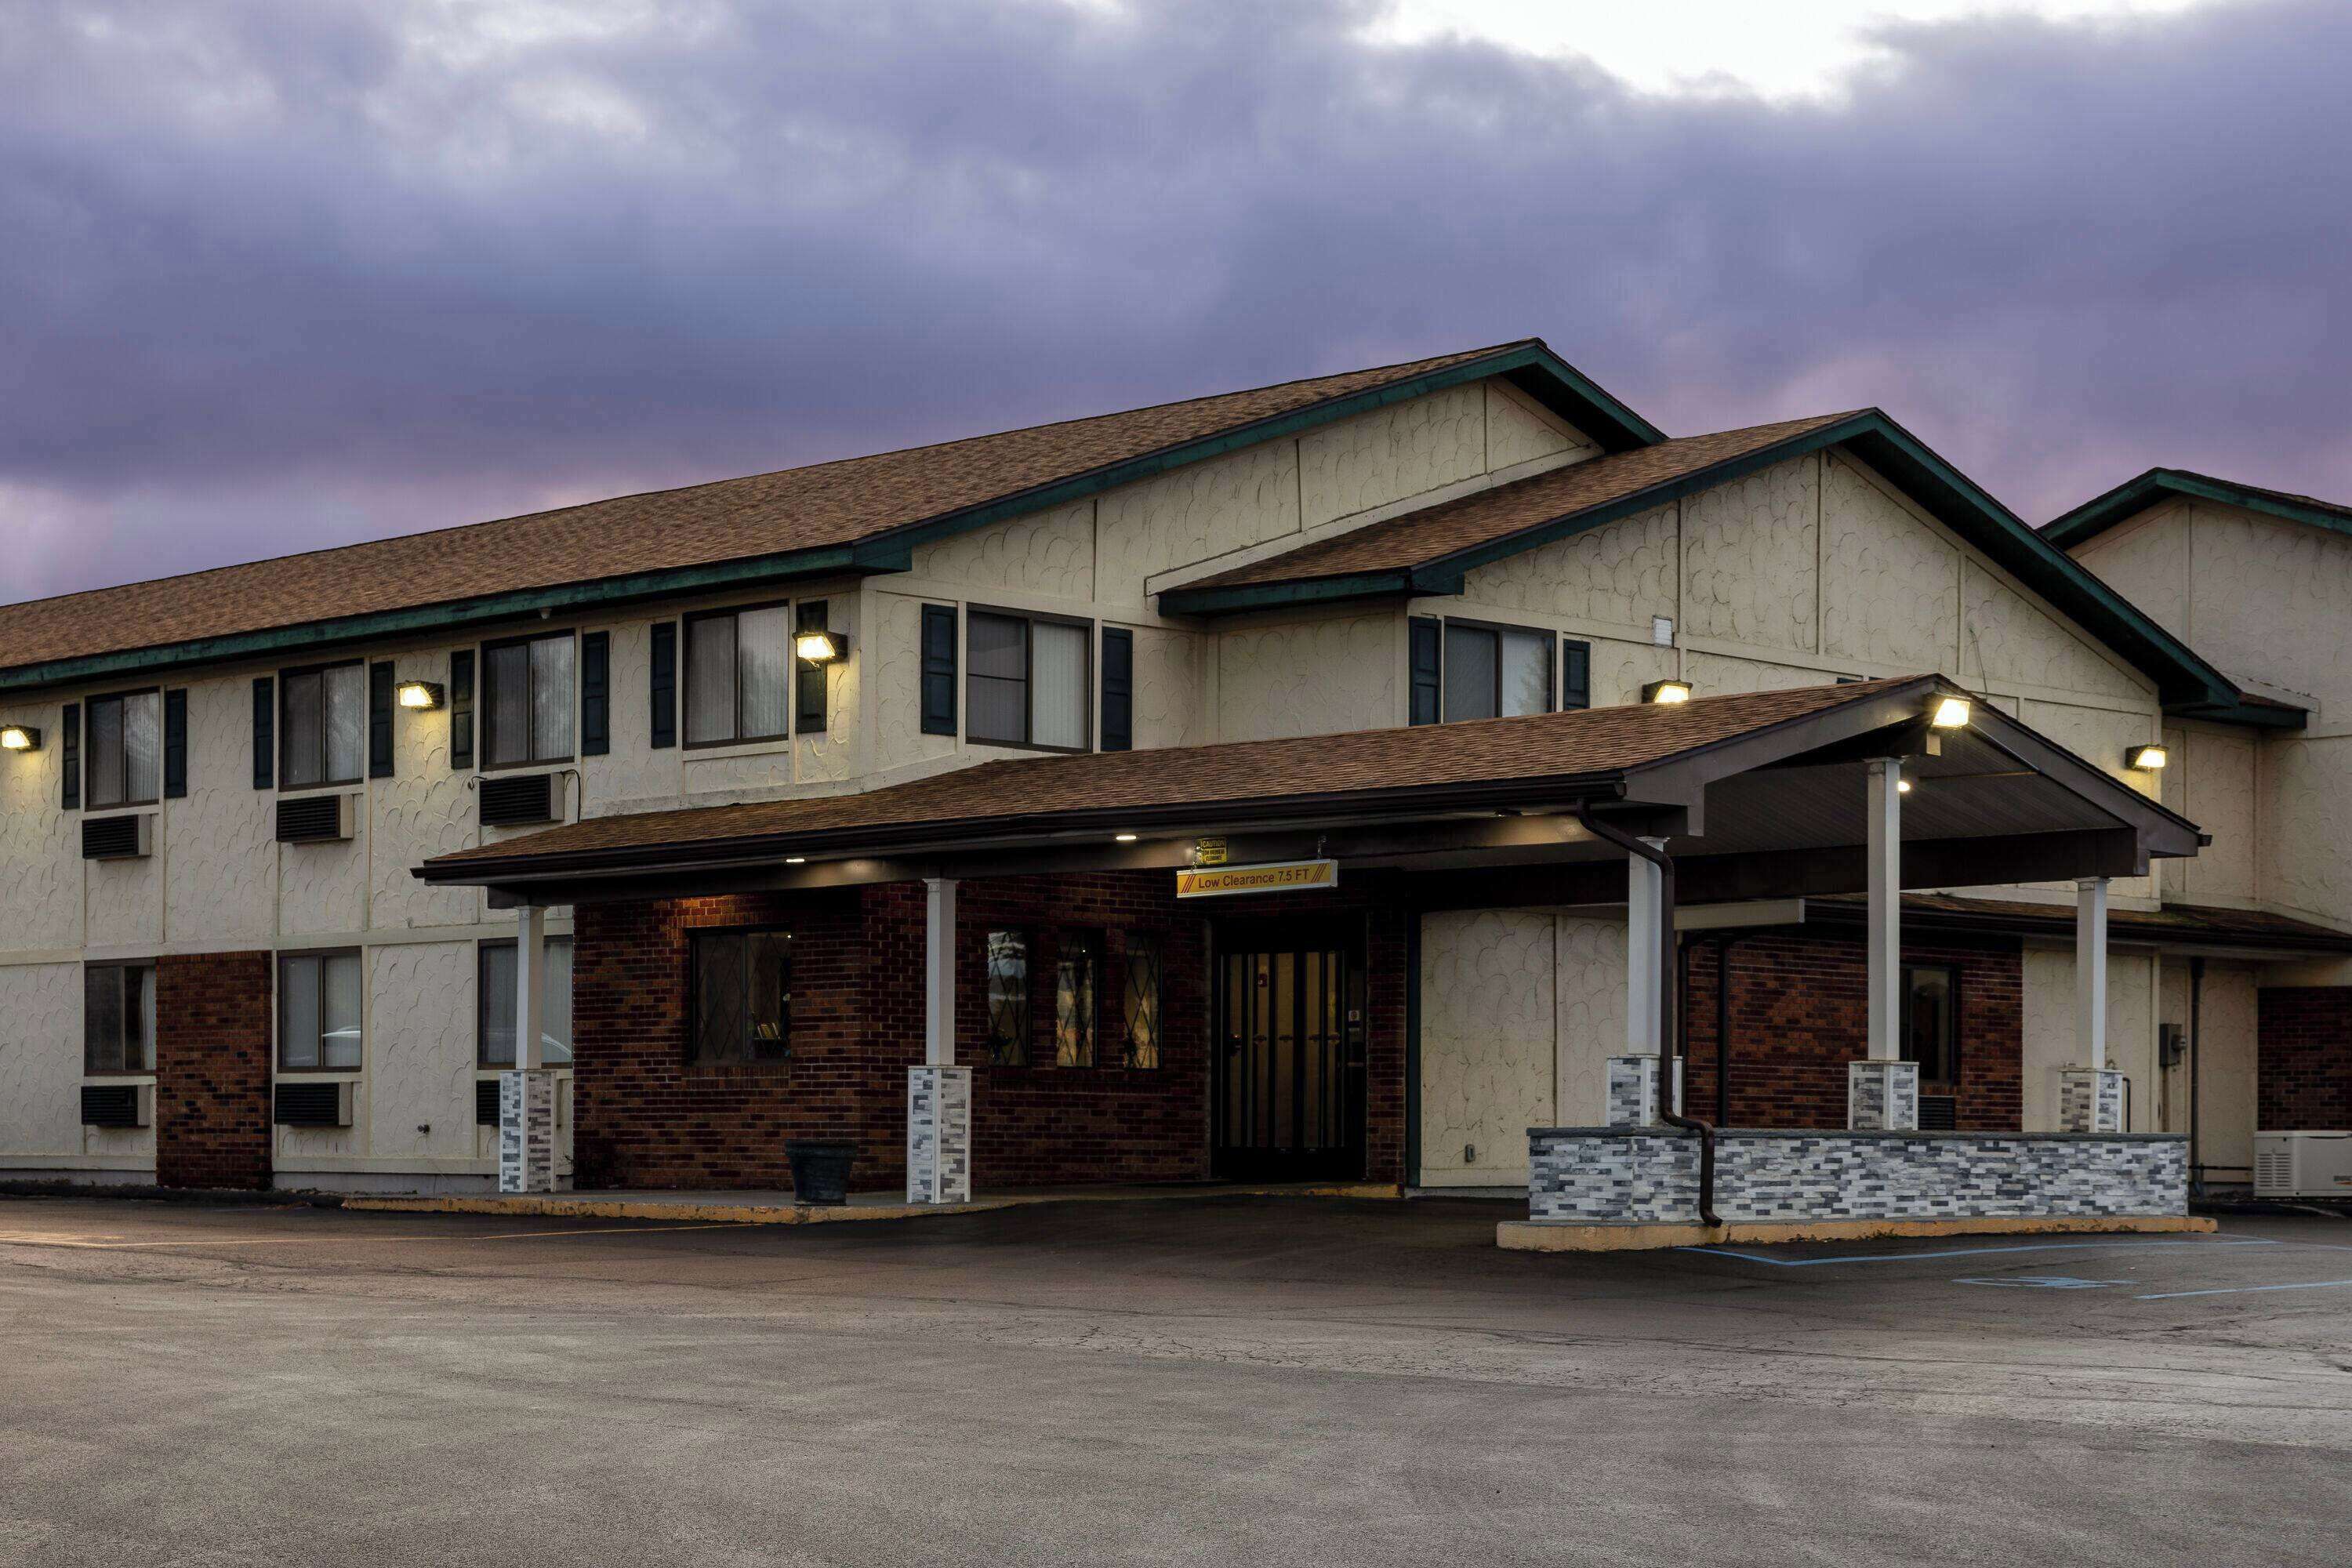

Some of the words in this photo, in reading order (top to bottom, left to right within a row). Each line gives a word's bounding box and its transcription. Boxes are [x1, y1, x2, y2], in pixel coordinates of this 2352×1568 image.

[1198, 877, 1220, 888] Low
[1223, 873, 1275, 887] Clearance
[1279, 870, 1292, 882] 7.5
[1296, 869, 1310, 880] FT
